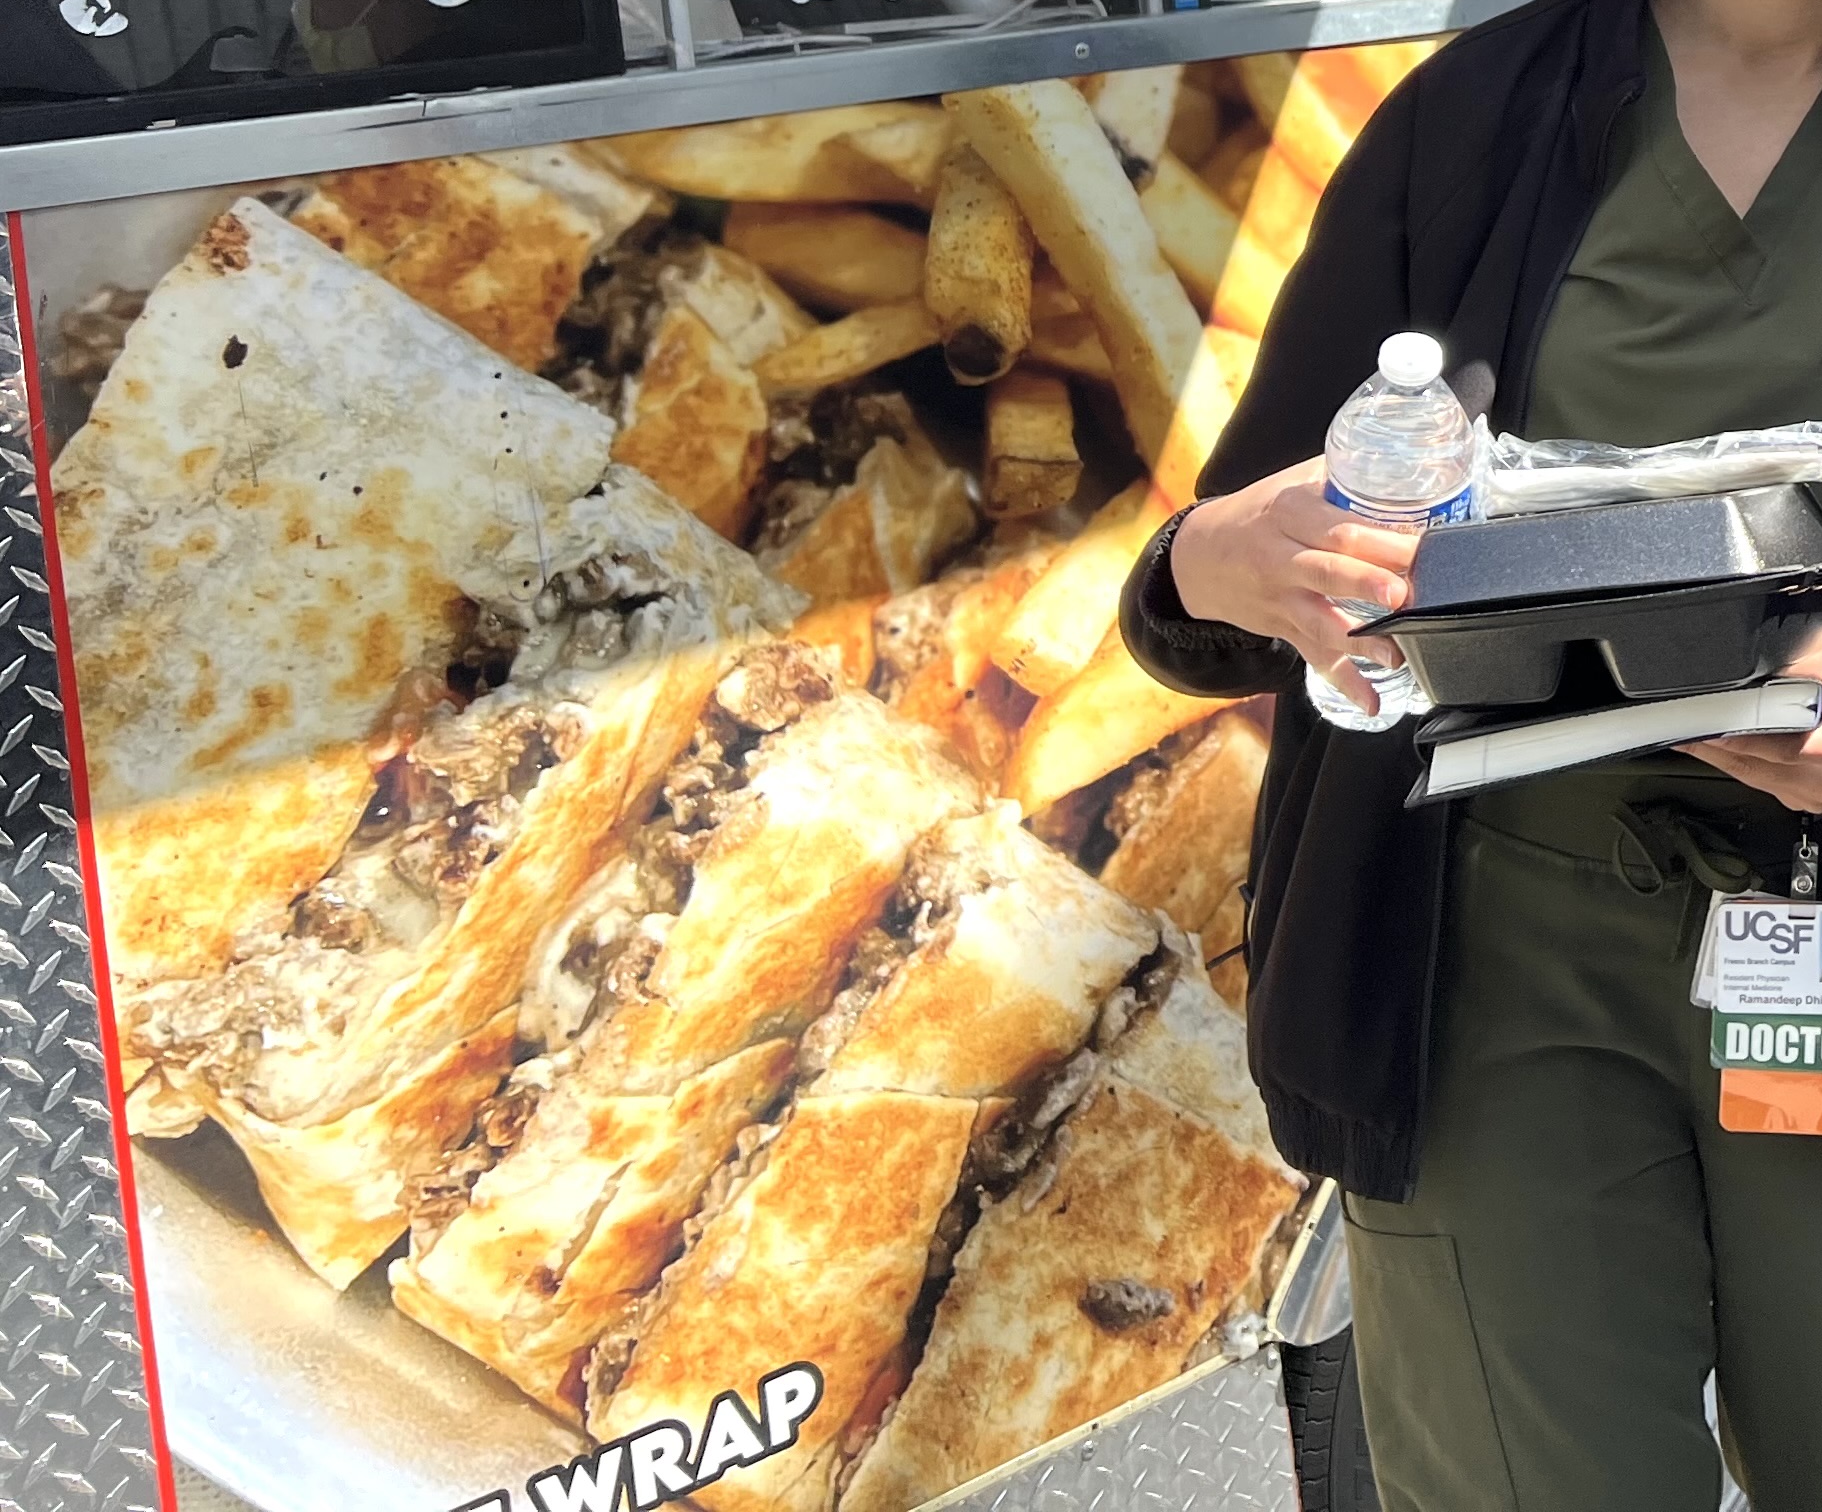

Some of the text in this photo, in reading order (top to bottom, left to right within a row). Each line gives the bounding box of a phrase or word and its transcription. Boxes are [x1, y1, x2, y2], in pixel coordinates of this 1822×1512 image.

[1725, 910, 1815, 955] UCSF
[1739, 994, 1803, 1006] Ramandeep
[530, 1365, 822, 1512] WRAP
